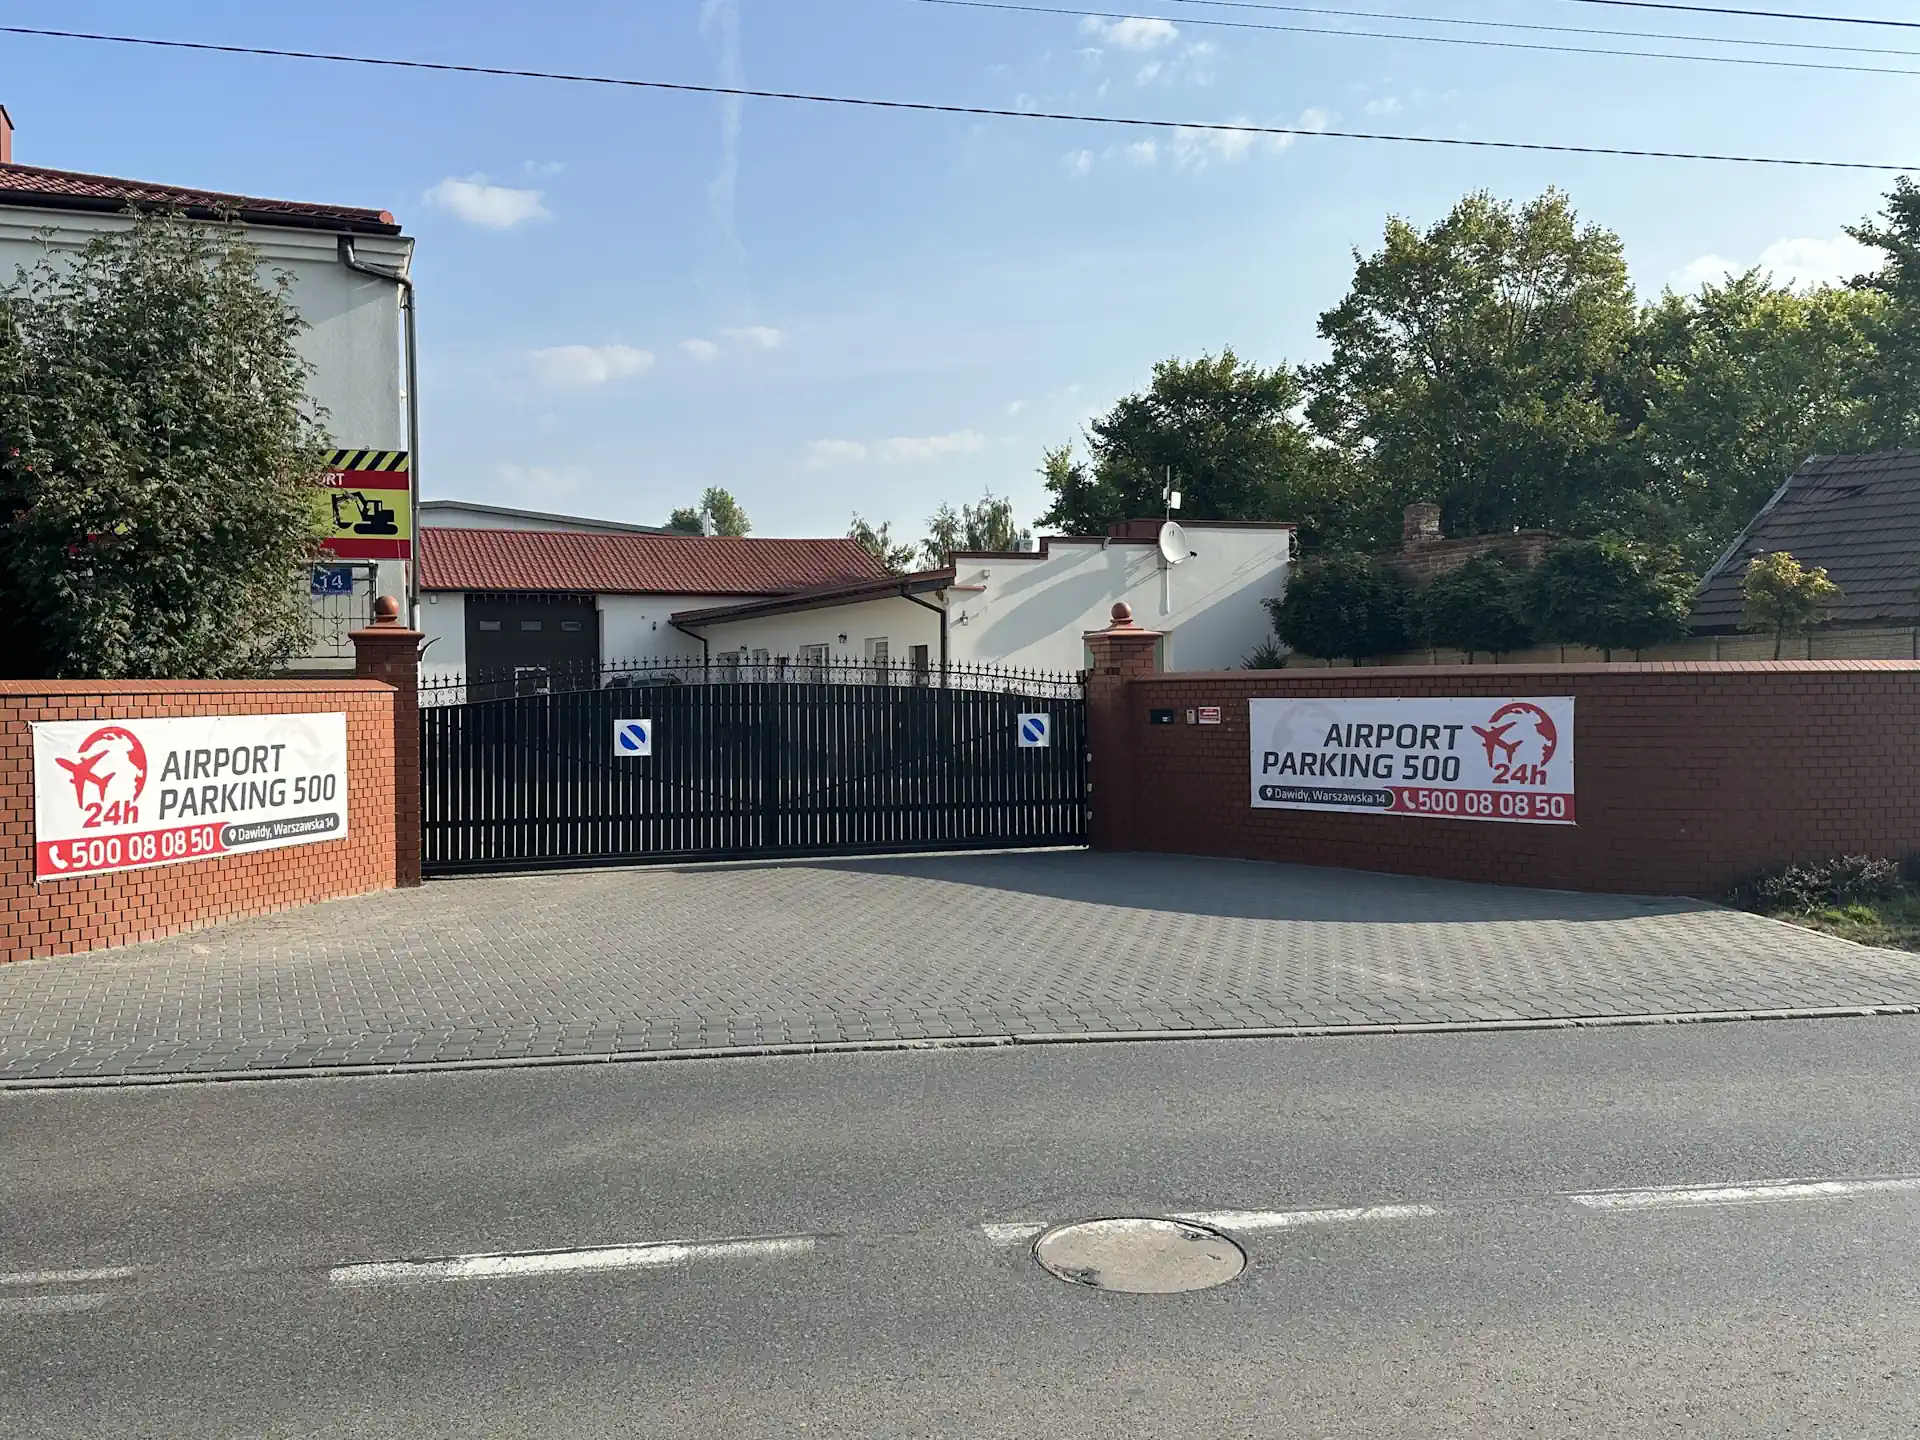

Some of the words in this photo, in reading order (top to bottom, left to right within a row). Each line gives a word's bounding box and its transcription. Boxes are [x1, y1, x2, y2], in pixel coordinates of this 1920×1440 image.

[319, 575, 343, 589] 14
[1323, 723, 1463, 750] AIRPORT
[160, 744, 286, 782] AIRPORT
[1262, 751, 1394, 779] PARKING
[1402, 755, 1460, 782] 500
[1492, 763, 1547, 785] 24h
[159, 778, 286, 820] PARKING
[293, 773, 336, 805] 500
[1274, 788, 1311, 802] Dawidy,
[1312, 790, 1373, 803] Warszawska
[1375, 793, 1386, 804] 14
[1418, 790, 1458, 813] 500
[1464, 792, 1494, 814] 08
[1499, 794, 1529, 816] 08
[1535, 795, 1565, 817] 50
[82, 800, 139, 829] 24h
[238, 824, 272, 841] Dawidy,
[273, 818, 325, 836] Warszawska
[325, 816, 334, 828] 14
[71, 837, 121, 869] 500
[128, 834, 157, 861] 08
[161, 830, 187, 857] 08
[191, 826, 214, 852] 50
